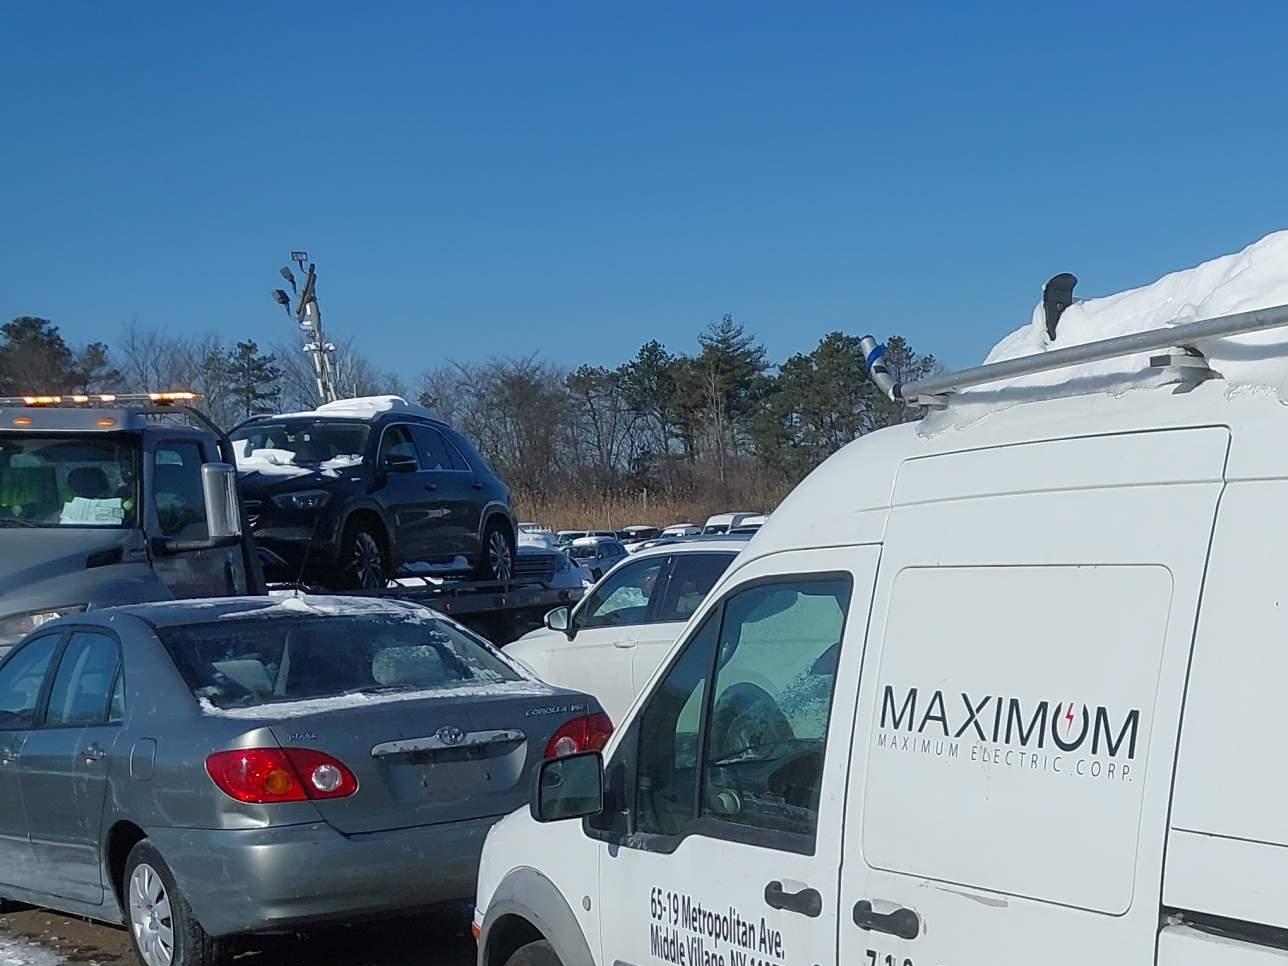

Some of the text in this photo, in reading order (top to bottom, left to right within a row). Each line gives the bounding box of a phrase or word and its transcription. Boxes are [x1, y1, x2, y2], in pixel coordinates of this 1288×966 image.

[880, 685, 1140, 759] MAXIMUM
[877, 733, 1132, 782] MAXIMUM ELECTRIC CORP.
[650, 886, 785, 960] 65-19 Metropolitan Ave.
[650, 923, 686, 966] Middle
